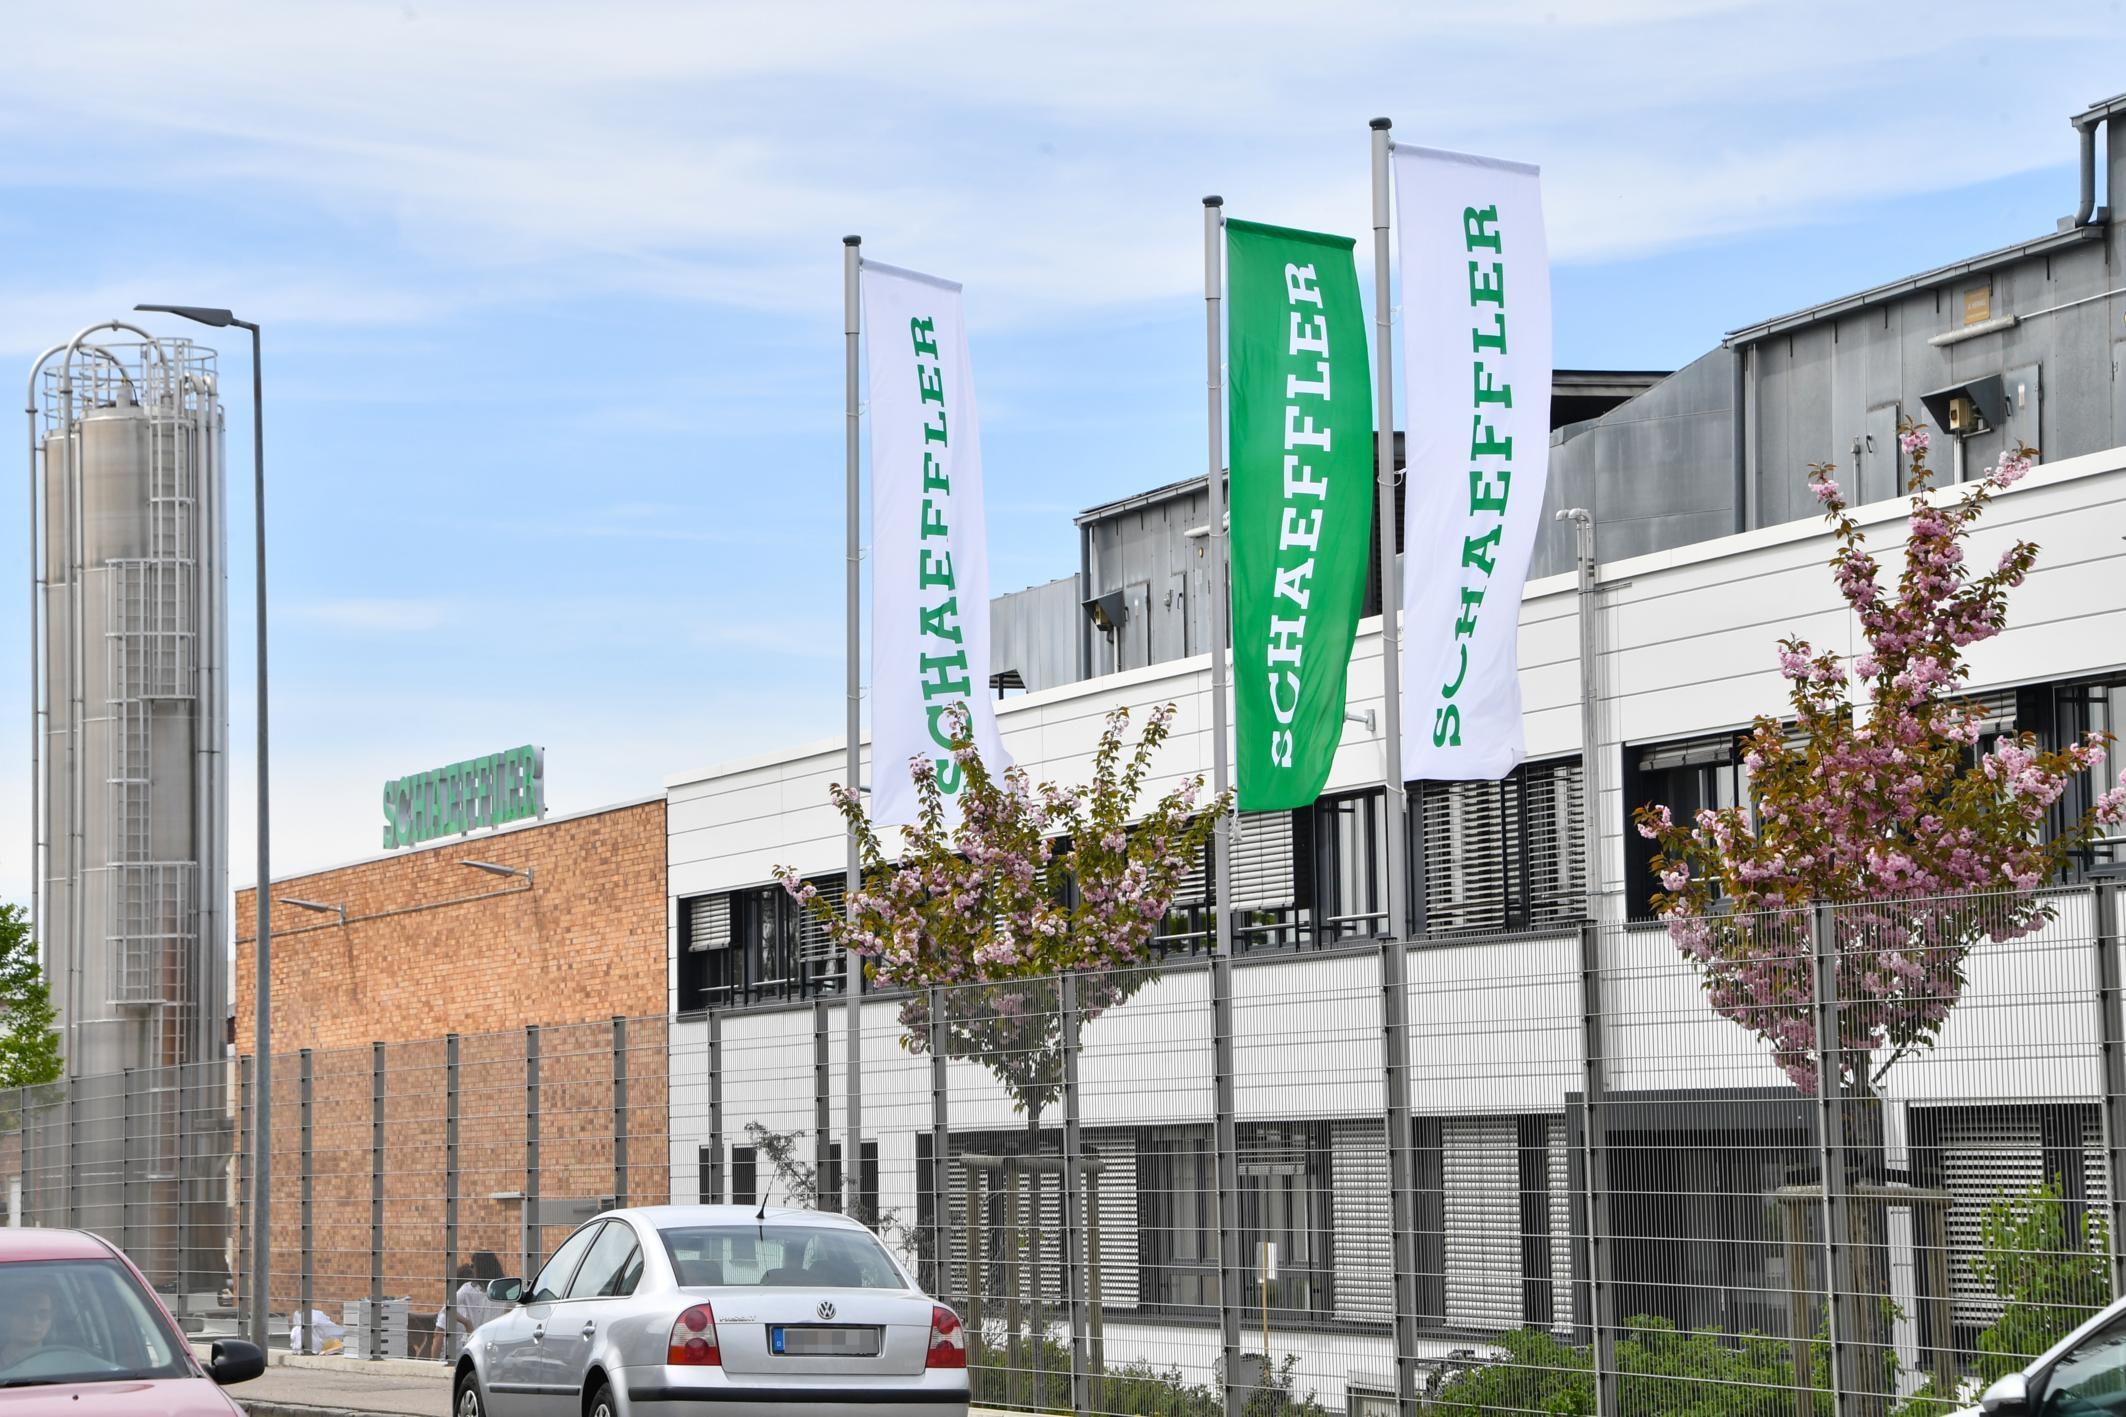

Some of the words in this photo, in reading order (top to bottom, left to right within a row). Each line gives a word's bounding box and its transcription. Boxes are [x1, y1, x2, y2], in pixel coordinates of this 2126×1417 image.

[1268, 263, 1331, 769] SCHAEFFLER
[1433, 205, 1513, 748] SCHAEFFLER
[383, 744, 540, 849] SCHAEFFLER
